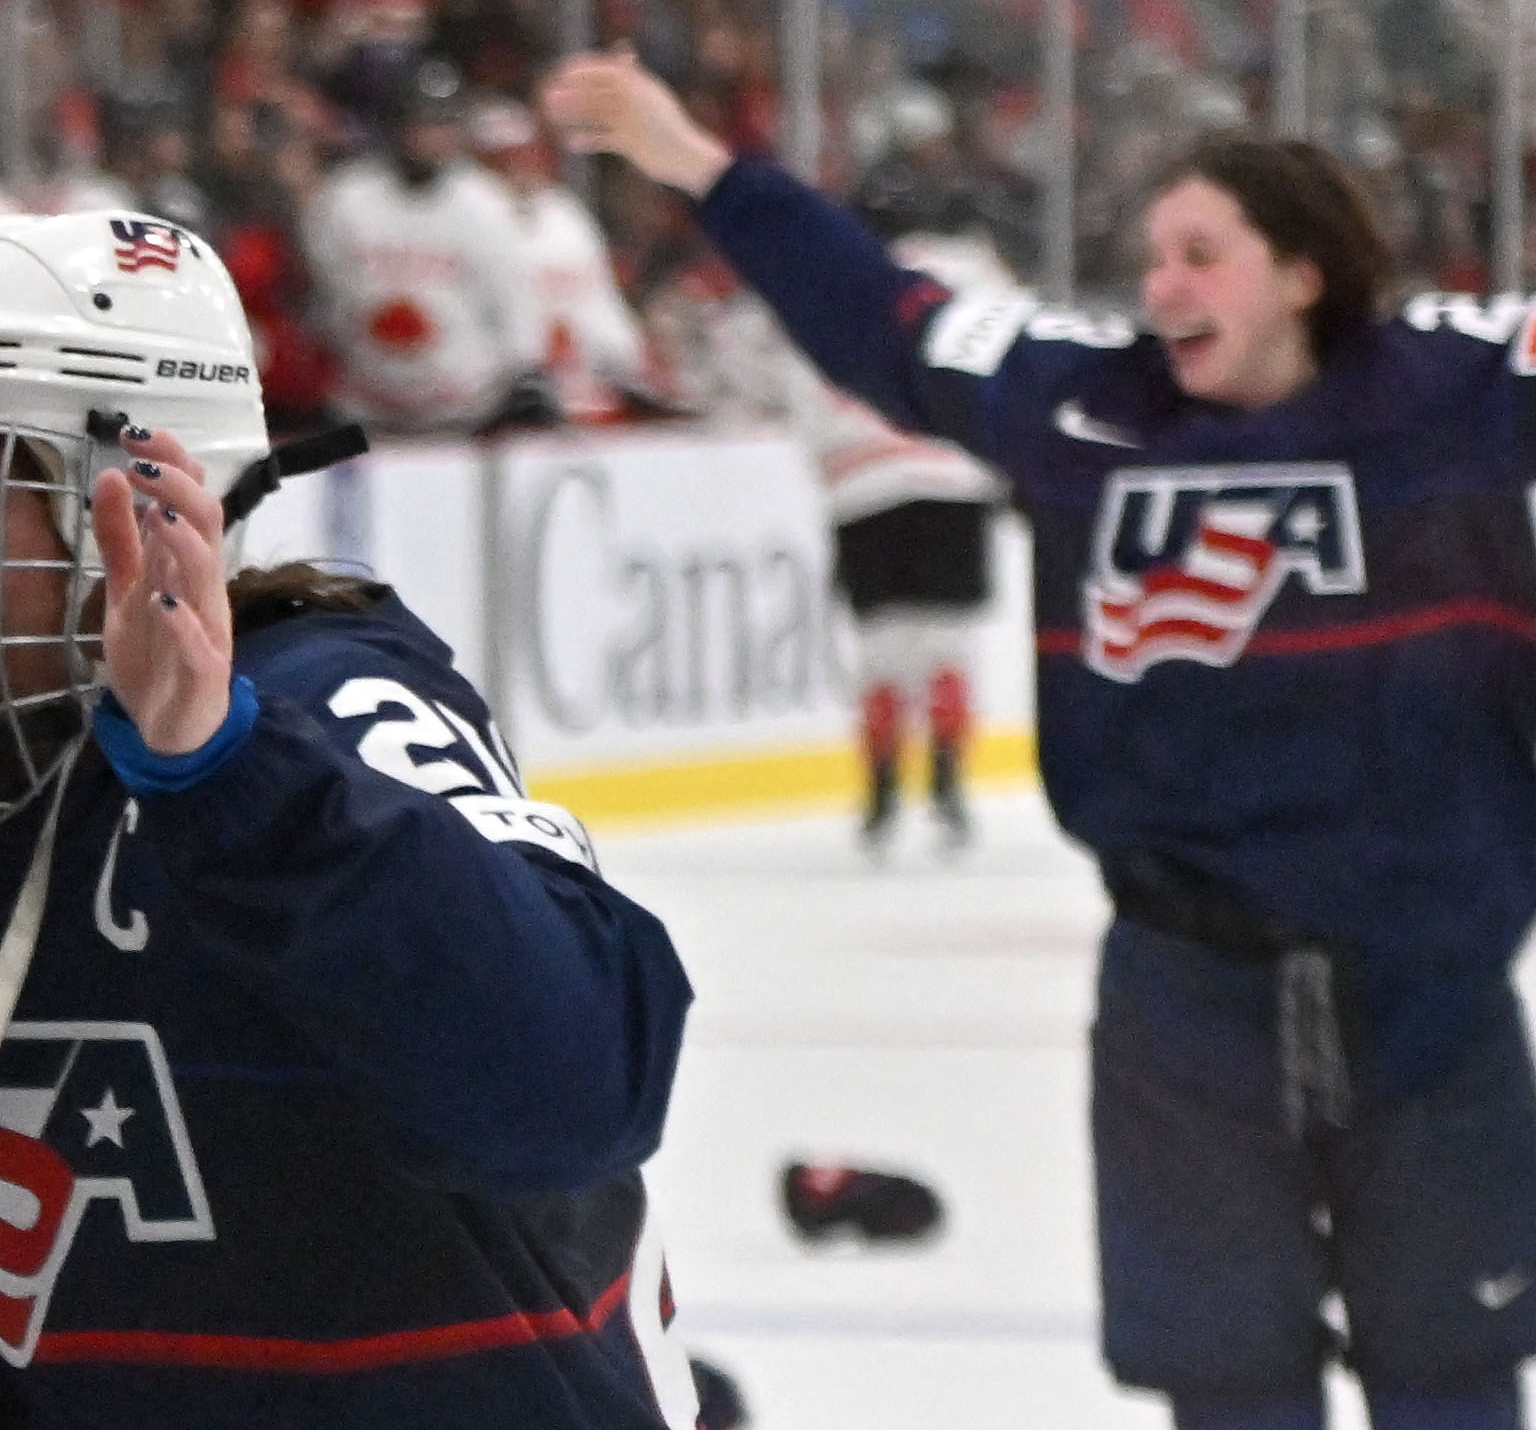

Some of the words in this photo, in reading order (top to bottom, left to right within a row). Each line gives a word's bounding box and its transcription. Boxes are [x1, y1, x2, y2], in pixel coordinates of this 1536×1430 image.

[156, 359, 249, 384] BAUER
[510, 465, 827, 736] Cana
[1085, 461, 1368, 683] USA
[94, 797, 150, 951] C
